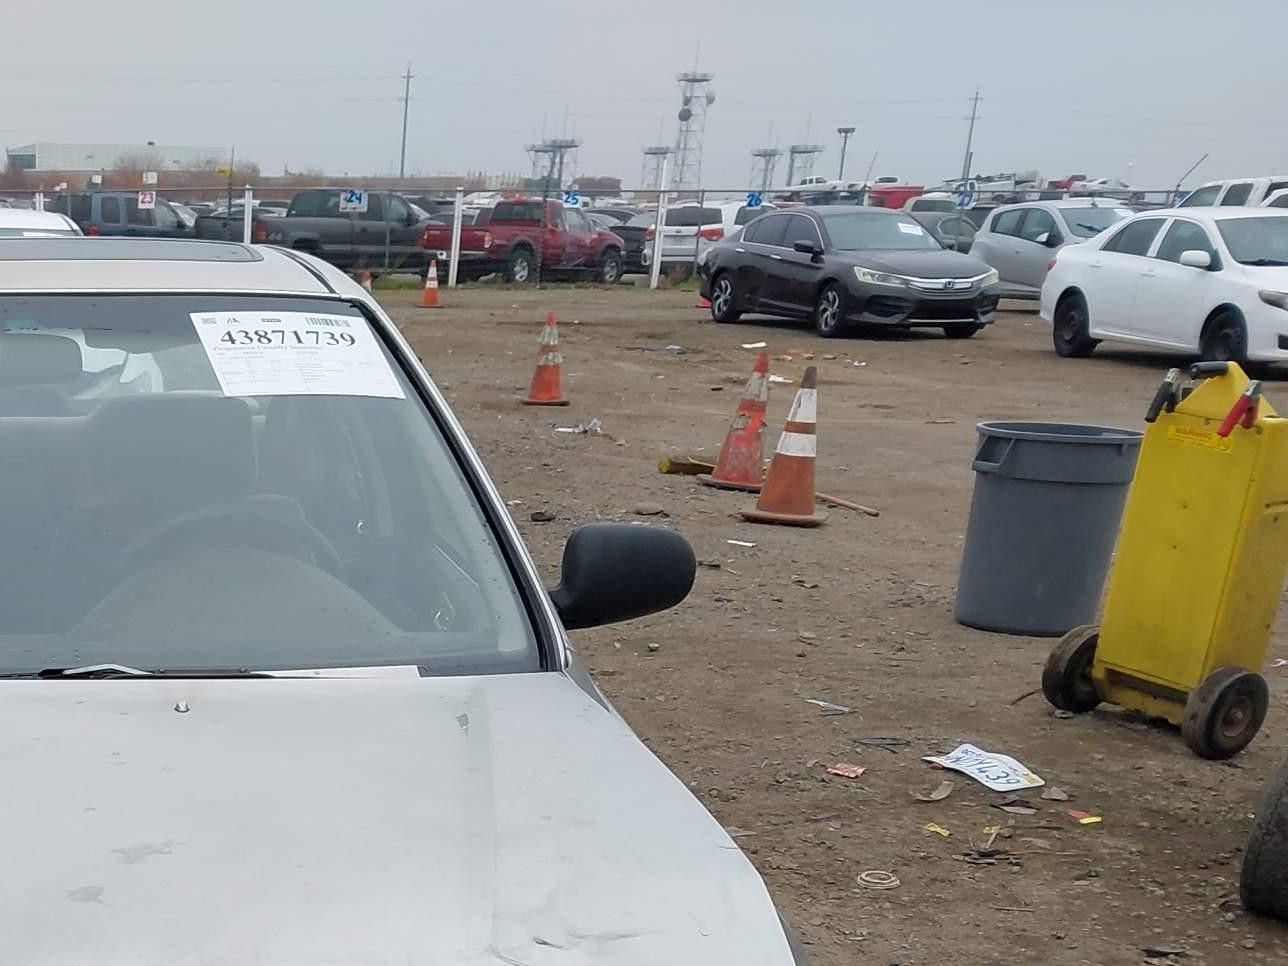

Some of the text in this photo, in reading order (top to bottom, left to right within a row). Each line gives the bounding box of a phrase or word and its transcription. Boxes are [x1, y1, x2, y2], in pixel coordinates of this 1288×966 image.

[346, 190, 362, 205] 24
[564, 191, 579, 205] 25
[747, 192, 762, 207] 26
[221, 330, 356, 346] 43871739
